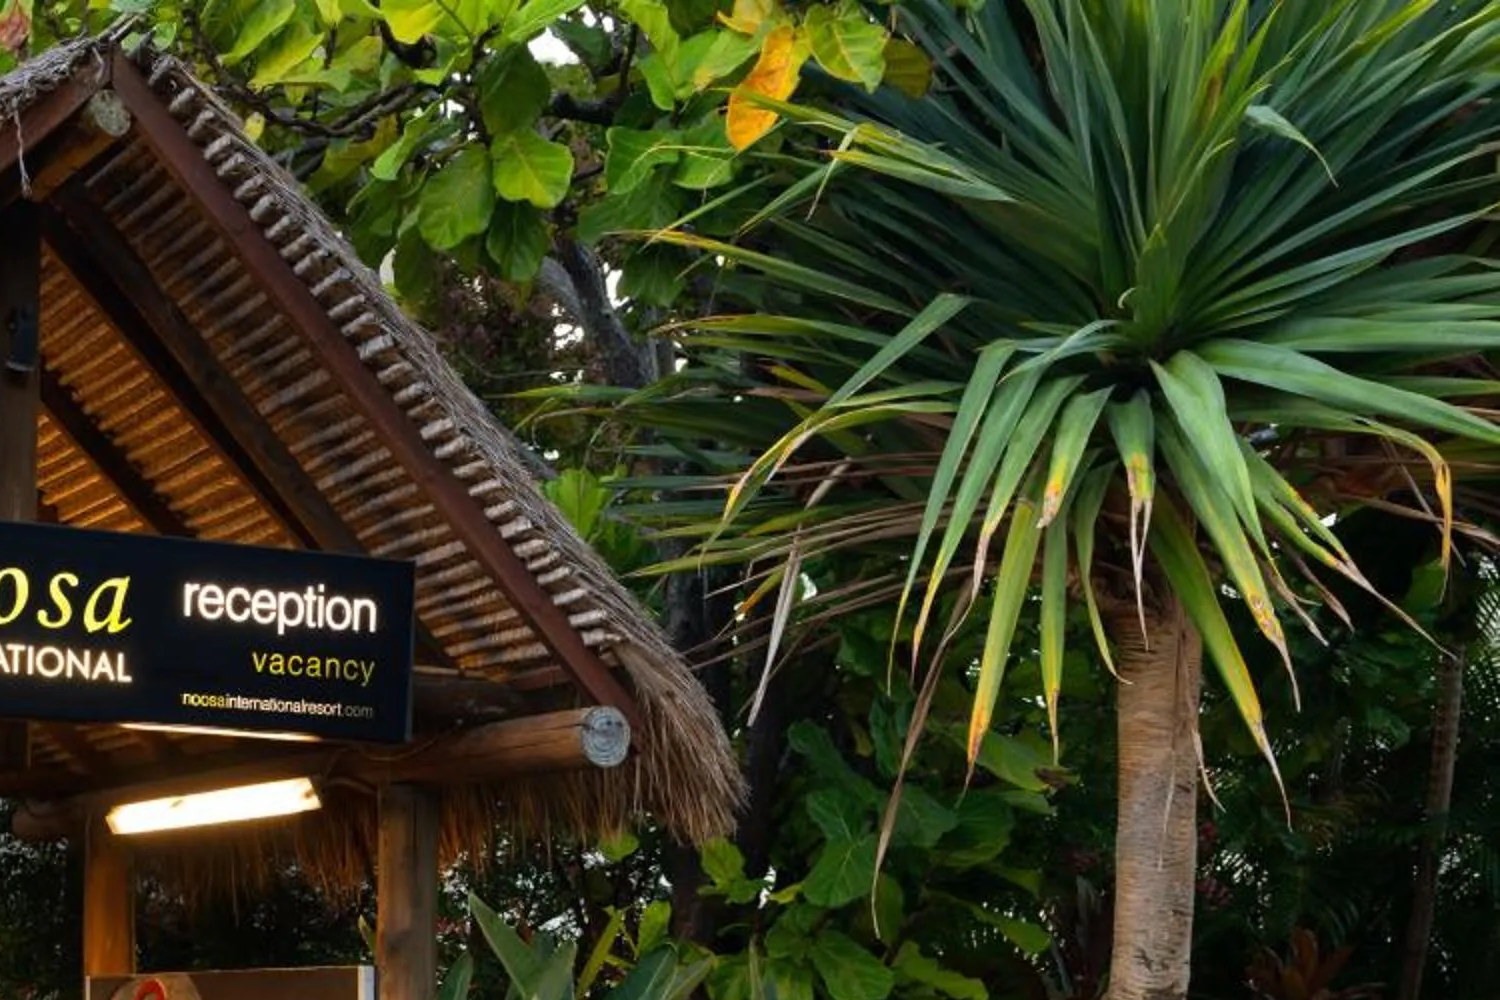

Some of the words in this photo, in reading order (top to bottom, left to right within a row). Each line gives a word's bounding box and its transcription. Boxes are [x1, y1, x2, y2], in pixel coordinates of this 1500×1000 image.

[183, 581, 378, 636] reception
[252, 651, 376, 687] vacancy
[181, 692, 374, 719] noosainternationalresort.com
